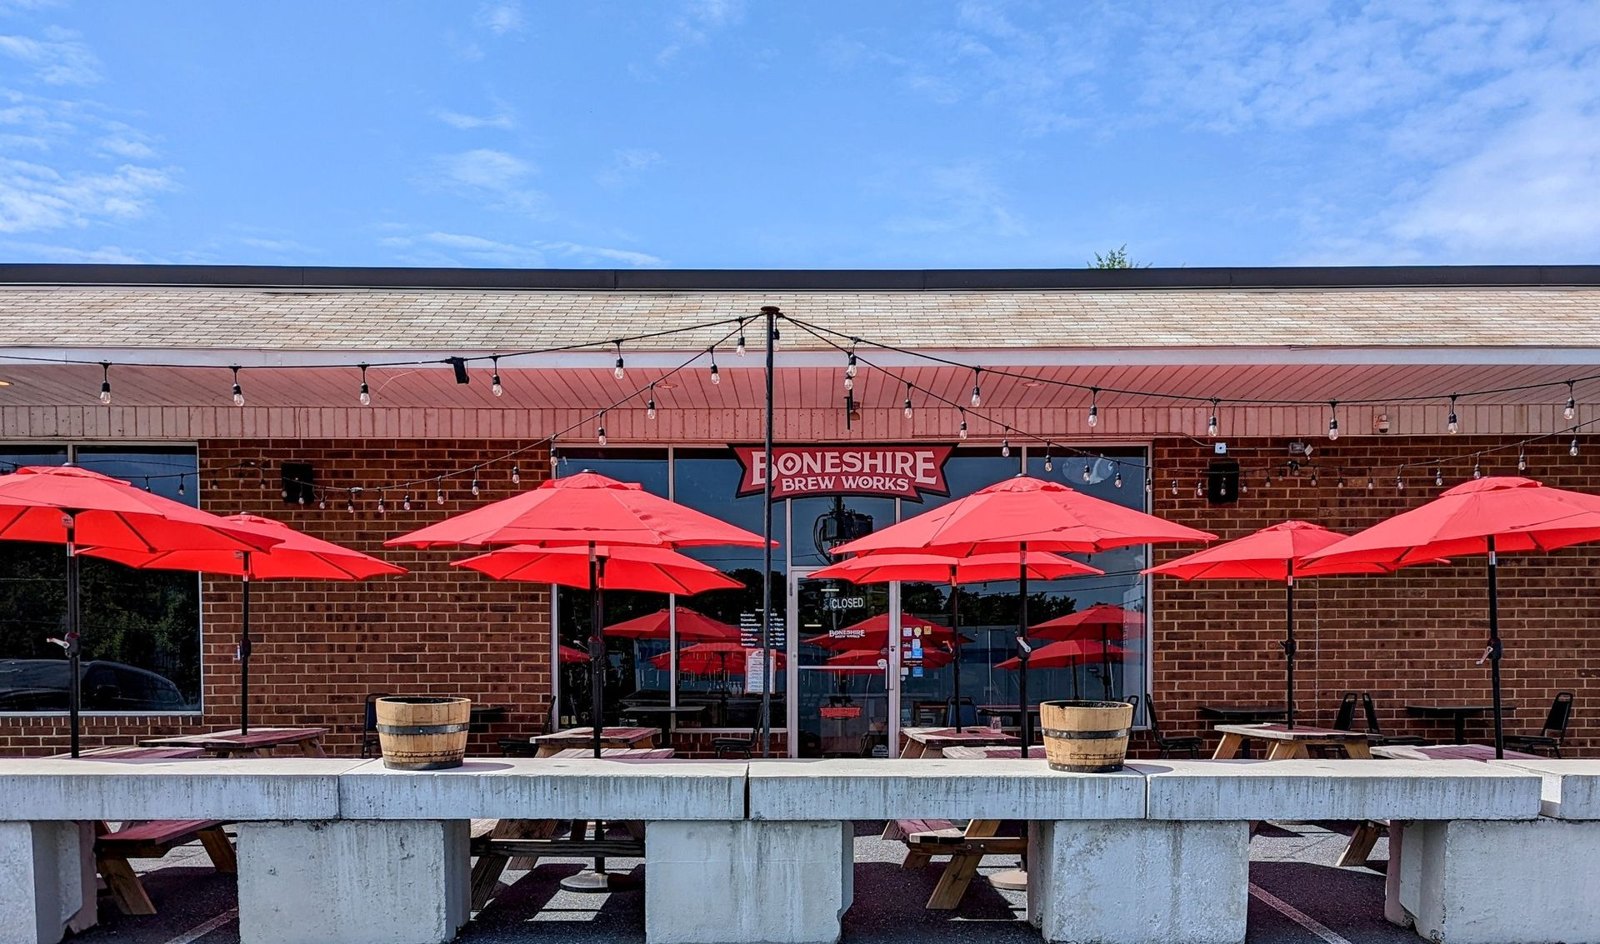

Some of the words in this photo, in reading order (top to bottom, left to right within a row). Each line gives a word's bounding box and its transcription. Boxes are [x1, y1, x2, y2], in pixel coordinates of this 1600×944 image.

[751, 451, 937, 485] BONESHIRE
[781, 475, 837, 492] BREW
[840, 475, 909, 491] WORKS
[831, 597, 864, 609] CLOSED
